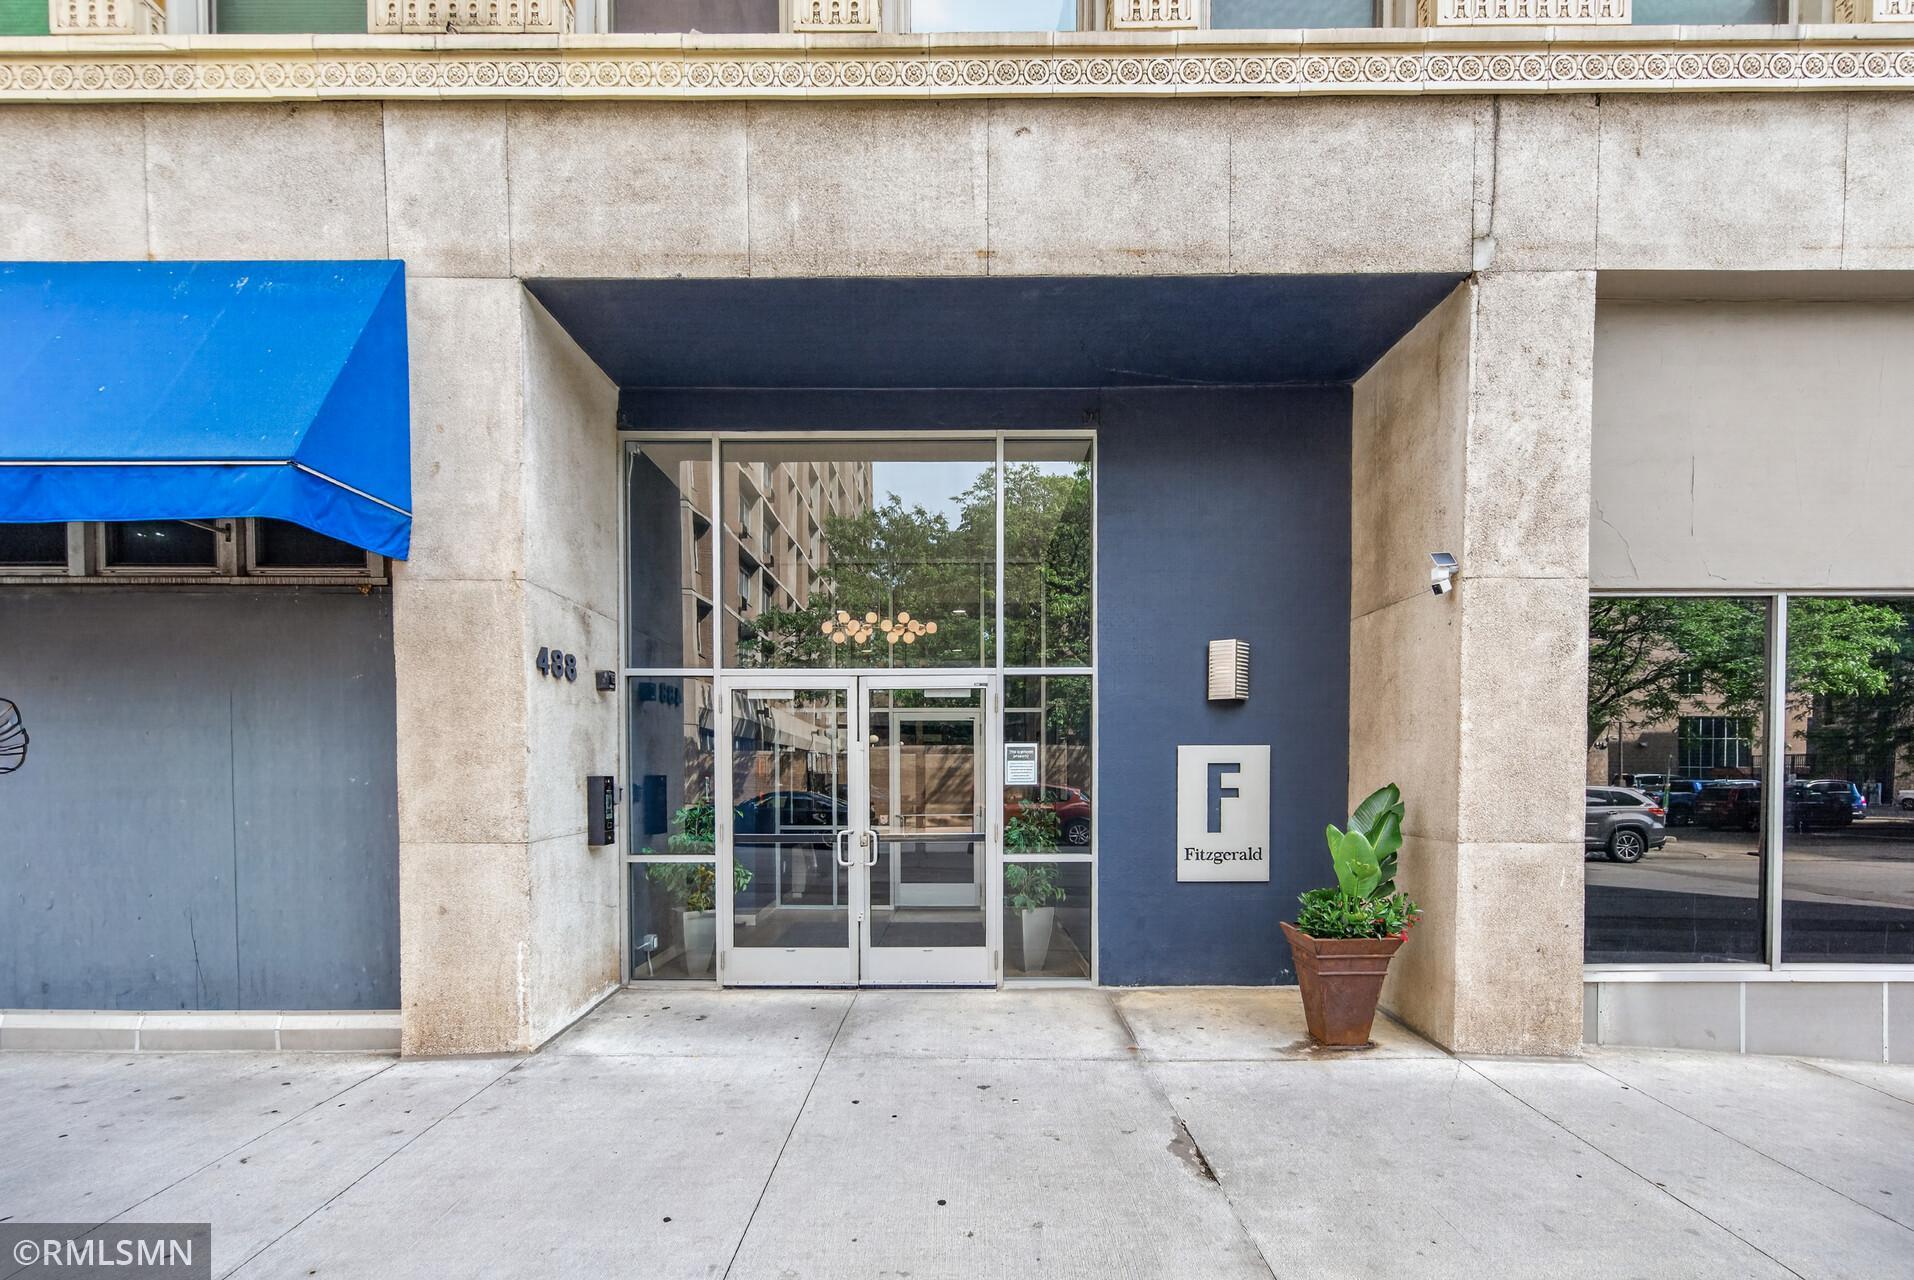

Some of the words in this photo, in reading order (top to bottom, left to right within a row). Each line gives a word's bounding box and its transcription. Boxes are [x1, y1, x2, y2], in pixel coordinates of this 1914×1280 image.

[536, 647, 577, 682] 488
[1207, 763, 1240, 833] F
[1184, 847, 1263, 864] Fitzgerald
